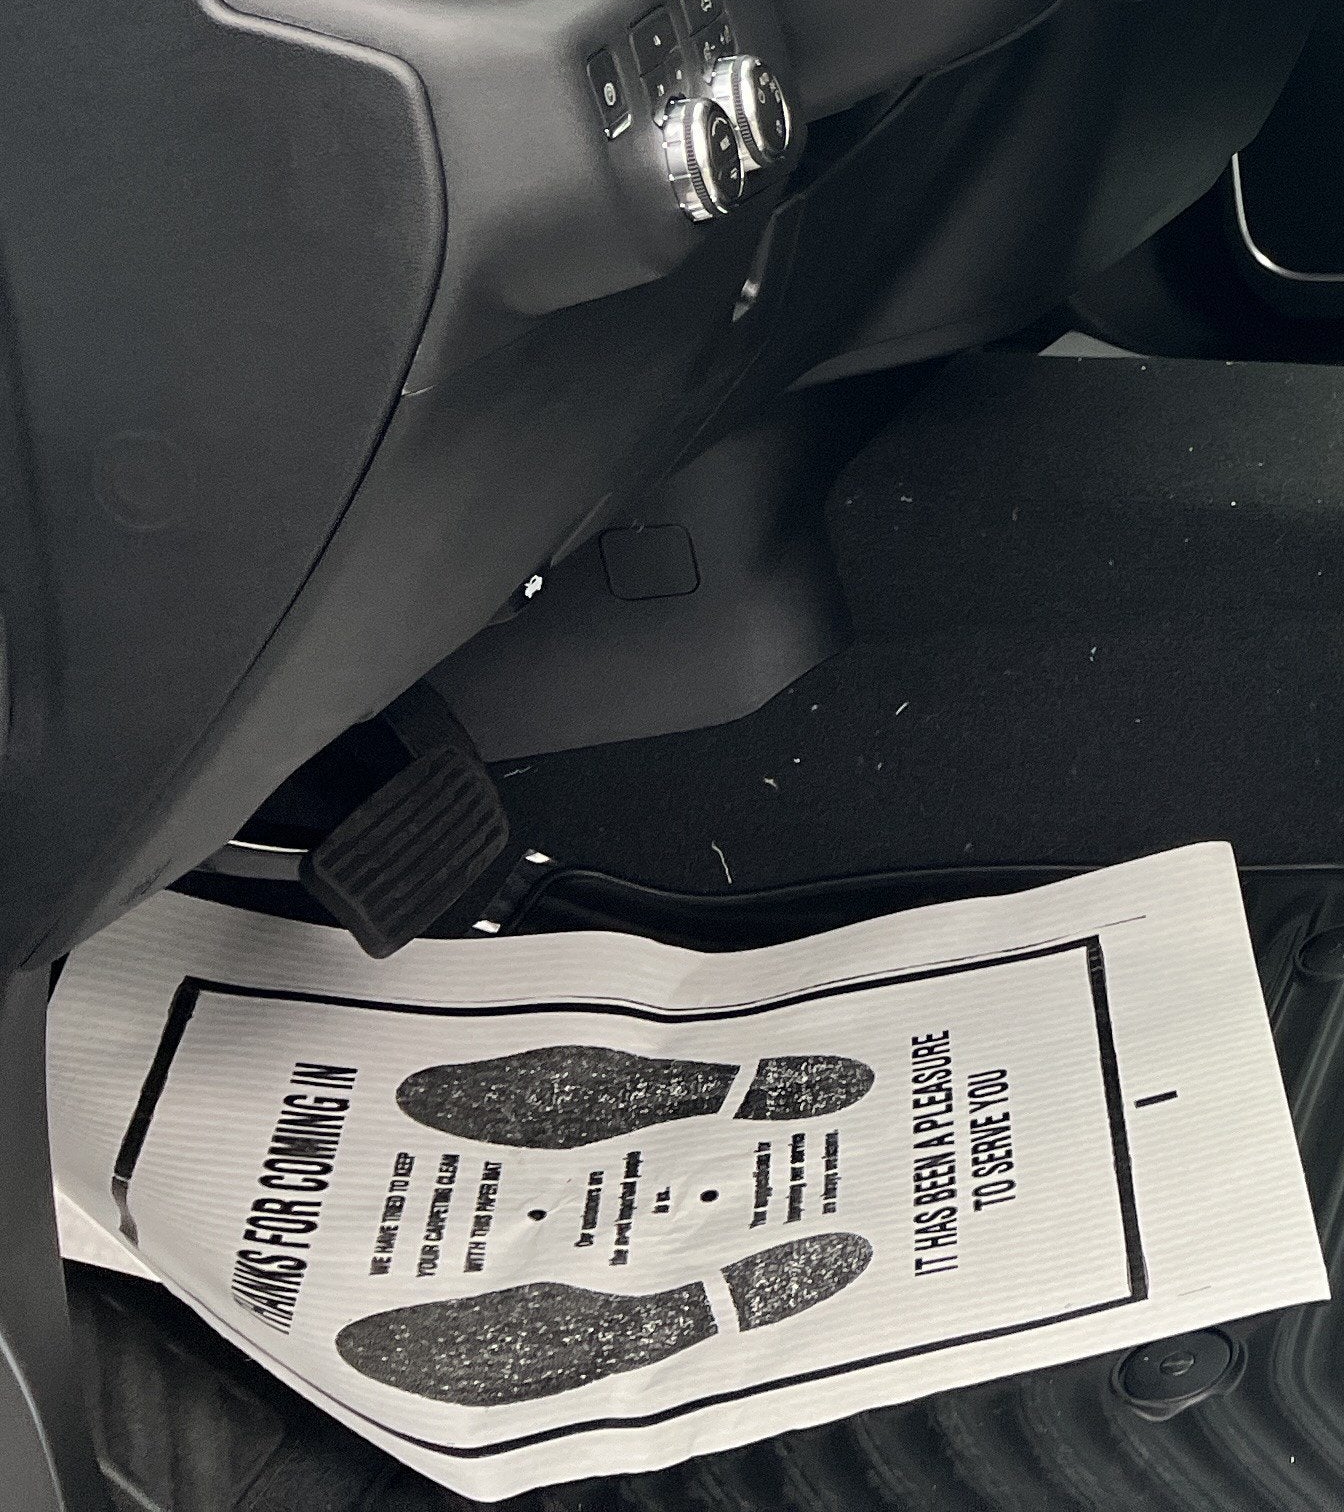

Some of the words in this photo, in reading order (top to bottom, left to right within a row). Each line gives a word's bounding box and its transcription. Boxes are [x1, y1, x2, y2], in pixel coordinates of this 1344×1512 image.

[289, 1061, 359, 1090] IN
[911, 1029, 955, 1135] PLEASURE
[967, 1068, 1009, 1115] YOU
[257, 1094, 351, 1192] COMING
[912, 1131, 955, 1149] A
[969, 1111, 1014, 1179] SERVE
[388, 1180, 410, 1193] TO
[912, 1151, 958, 1207] BEEN
[971, 1178, 1017, 1213] TO
[242, 1197, 323, 1249] FOR
[912, 1205, 959, 1252] HAS
[914, 1255, 959, 1277] IT
